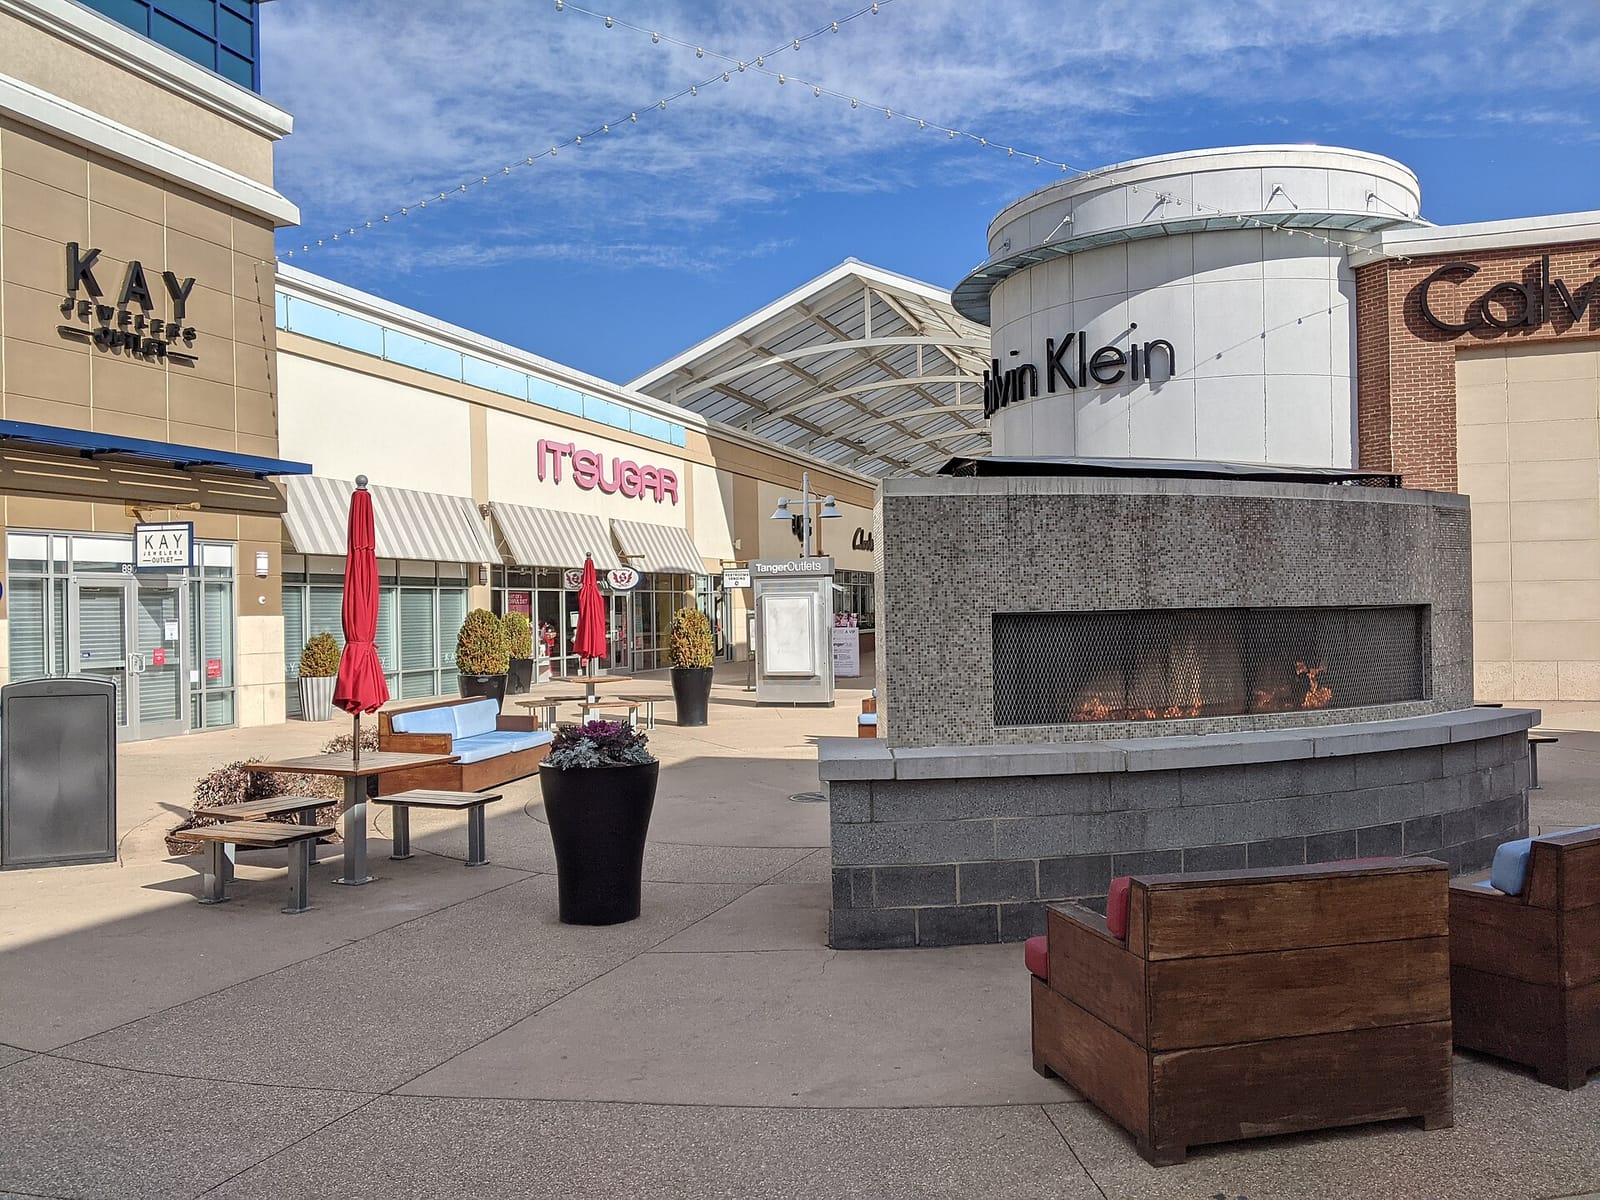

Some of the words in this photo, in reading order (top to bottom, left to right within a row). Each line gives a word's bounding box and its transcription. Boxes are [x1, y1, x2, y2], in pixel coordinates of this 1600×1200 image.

[65, 242, 196, 319] KAY
[60, 297, 197, 341] JEWELERS
[92, 326, 171, 357] OUTLET
[983, 350, 1038, 419] alvin
[1046, 322, 1175, 394] Klein
[537, 439, 679, 506] IT'SUGAR
[144, 533, 183, 549] KAY
[151, 556, 174, 564] OUTLET
[755, 561, 822, 574] TangerOutlets
